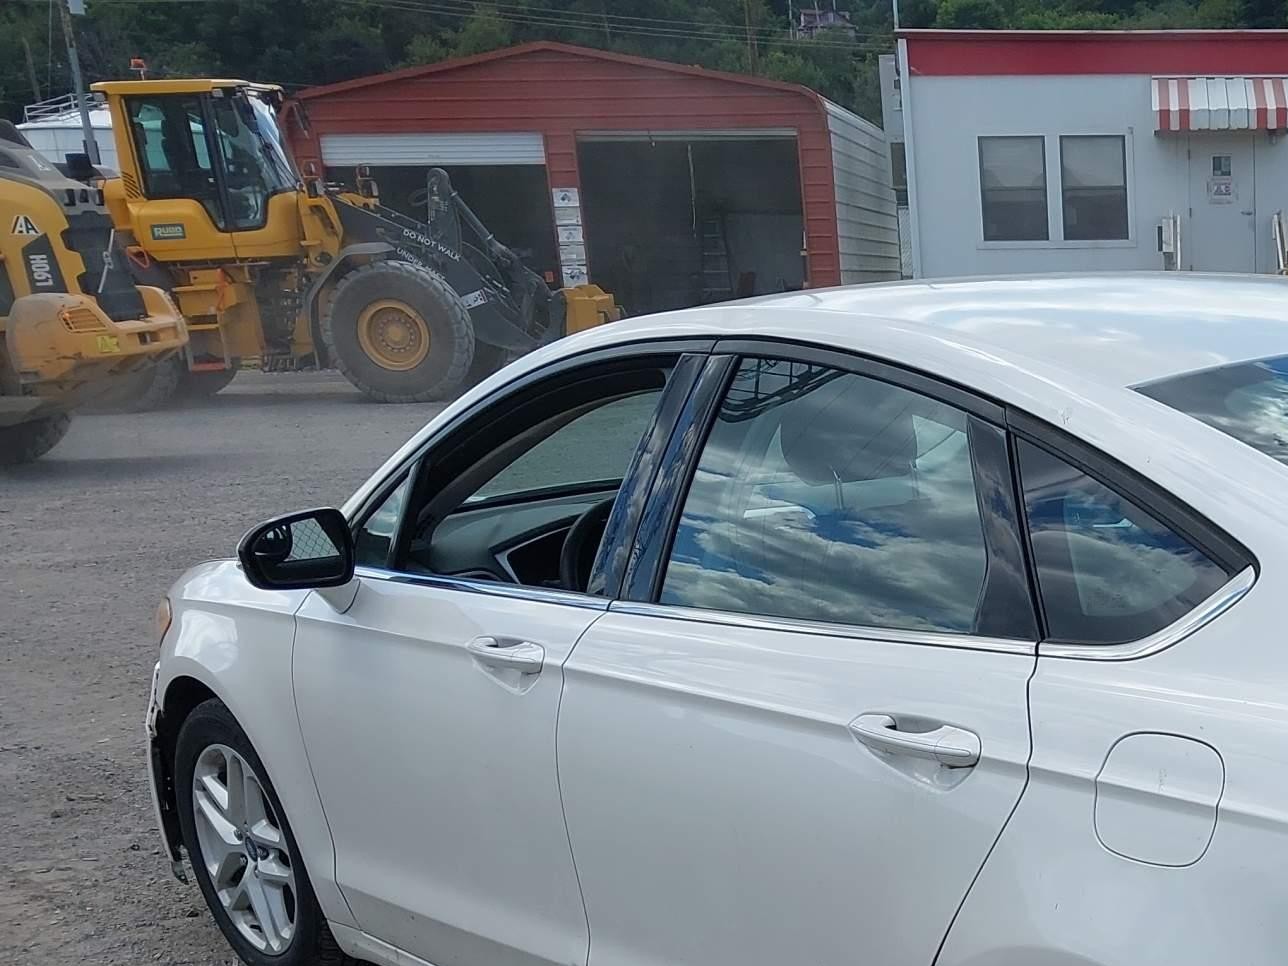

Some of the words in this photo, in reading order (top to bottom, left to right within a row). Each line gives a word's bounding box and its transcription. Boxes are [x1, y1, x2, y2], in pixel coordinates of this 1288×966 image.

[403, 229, 417, 239] DO
[417, 235, 437, 248] NOT
[437, 243, 461, 262] WALK
[28, 254, 53, 287] L90H
